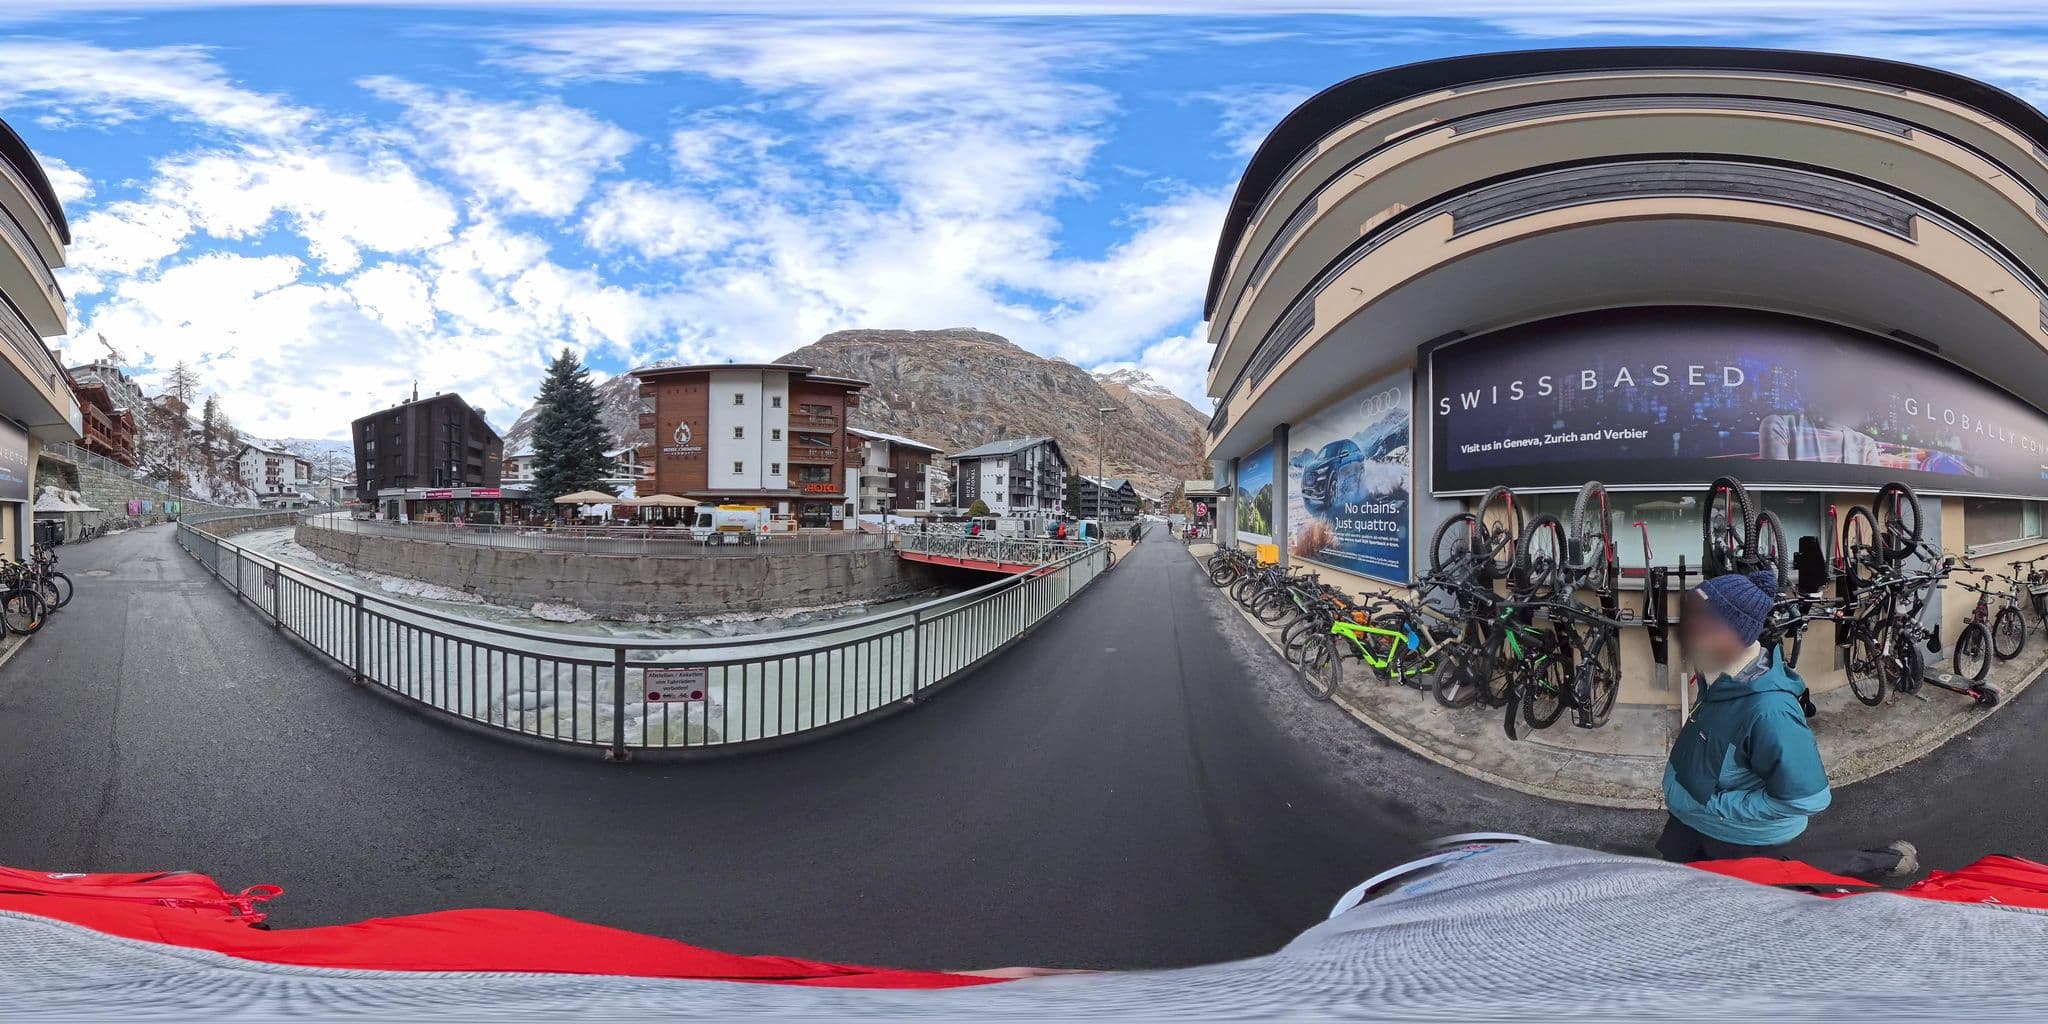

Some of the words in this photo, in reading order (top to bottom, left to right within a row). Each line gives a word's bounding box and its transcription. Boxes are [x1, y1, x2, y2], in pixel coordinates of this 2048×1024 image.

[1439, 375, 1553, 416] SWISS
[1581, 365, 1745, 390] BASED
[1905, 398, 2015, 446] GLOBALLY
[1460, 443, 1481, 454] Visit
[1481, 442, 1492, 451] us
[1493, 440, 1502, 450] in
[1503, 436, 1543, 450] Geneva,
[1544, 431, 1578, 445] Zurich
[1579, 429, 1602, 441] and
[1603, 428, 1648, 440] Verbier
[1345, 503, 1358, 514] No
[1360, 501, 1400, 514] chains.
[1335, 517, 1352, 530] Just
[1354, 519, 1400, 533] quattro.
